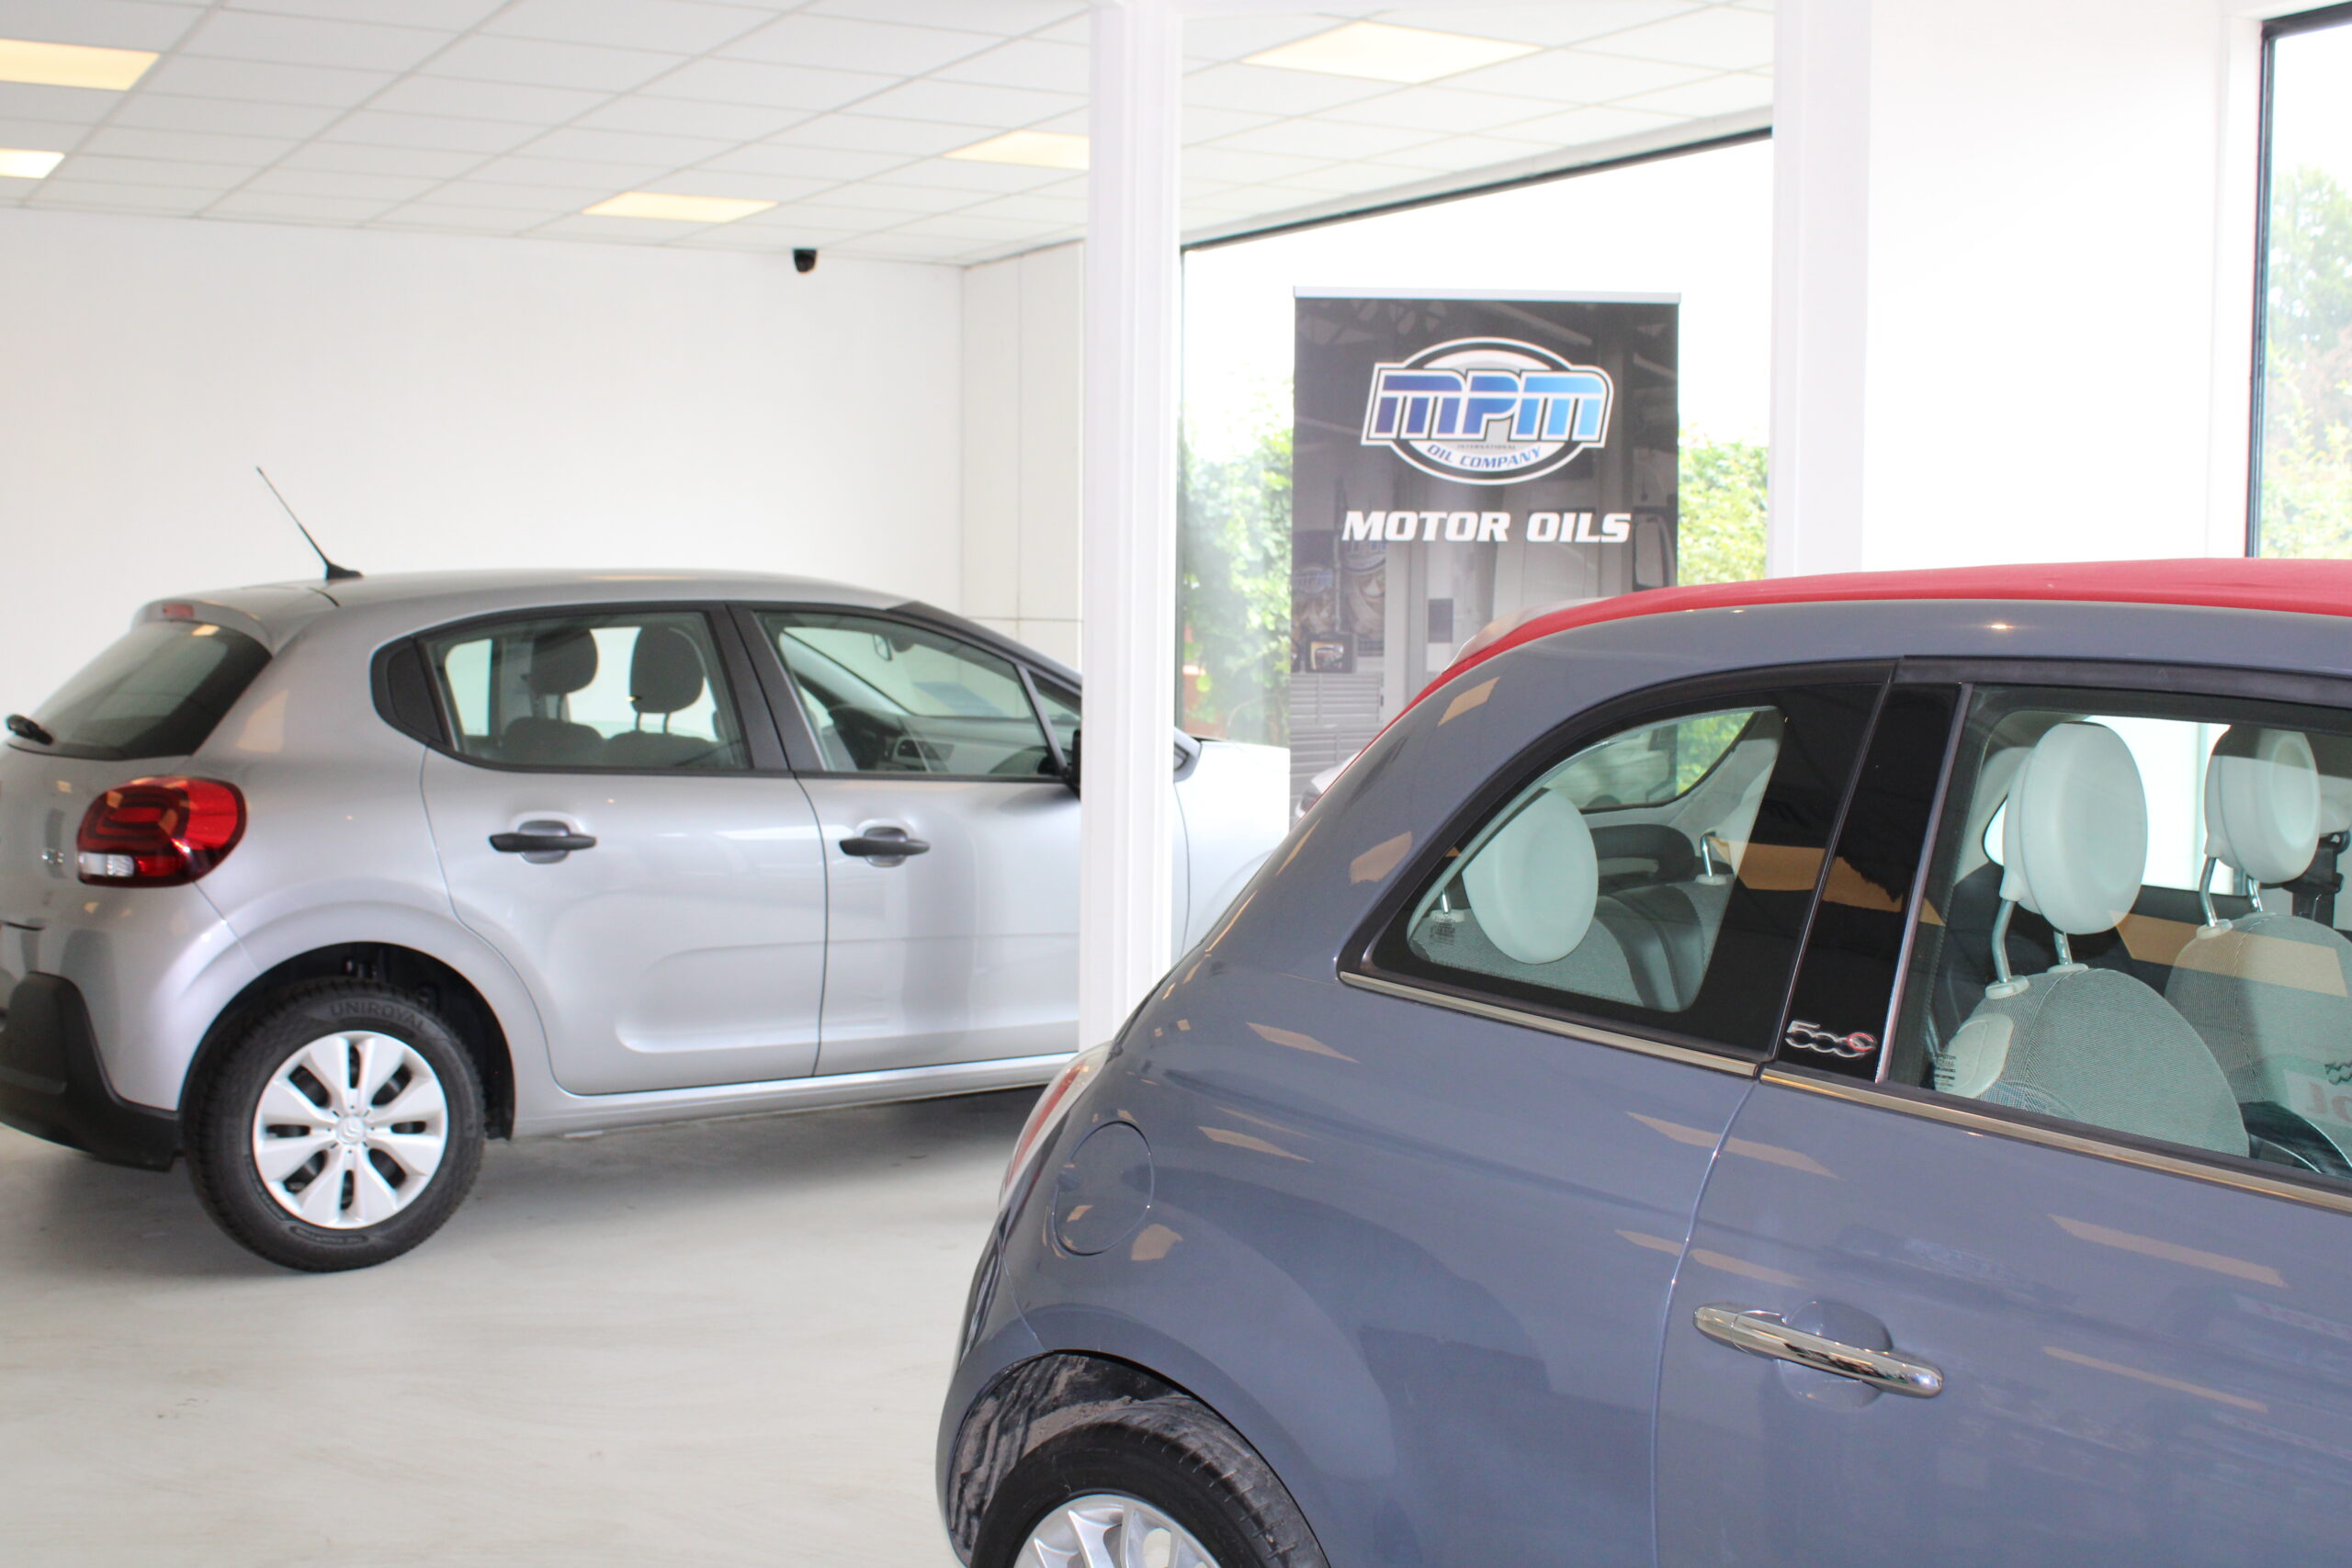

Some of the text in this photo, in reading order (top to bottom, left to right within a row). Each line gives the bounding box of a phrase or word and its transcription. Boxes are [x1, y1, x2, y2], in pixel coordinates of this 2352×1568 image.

[1427, 444, 1542, 468] OIL COMPANY
[1342, 511, 1632, 543] MOTOR OILS
[331, 1001, 425, 1032] UNIROYAL
[1785, 1020, 1877, 1058] 500
